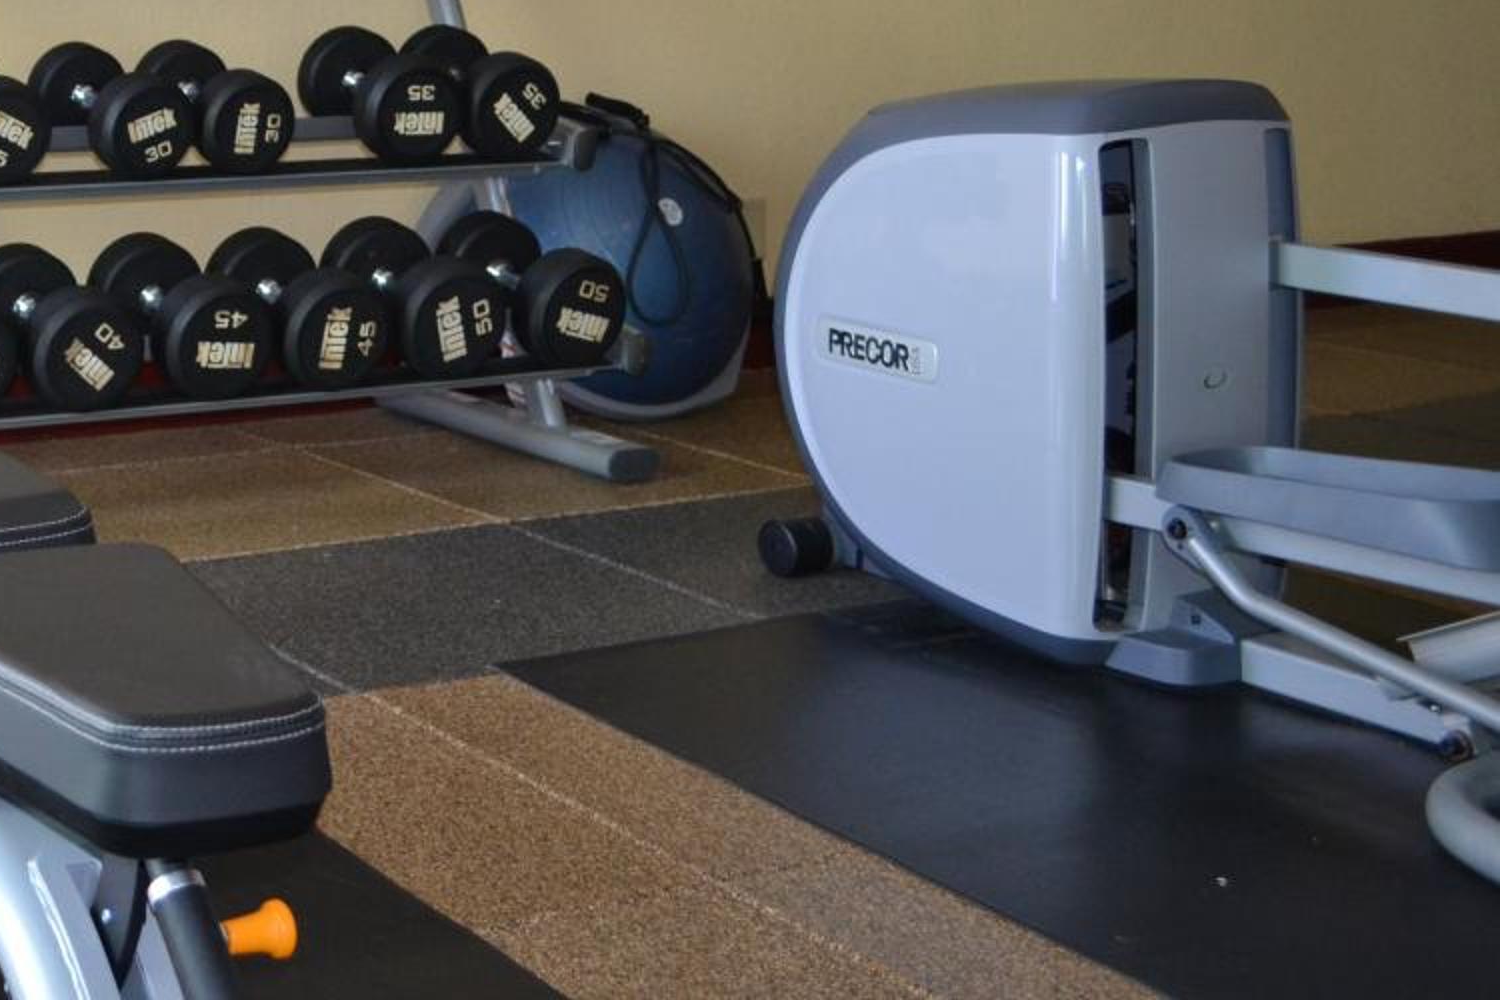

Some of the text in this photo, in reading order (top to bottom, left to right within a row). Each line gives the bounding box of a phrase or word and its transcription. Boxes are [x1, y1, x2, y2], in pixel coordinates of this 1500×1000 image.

[408, 85, 436, 101] 35
[522, 83, 547, 110] 35
[265, 114, 281, 143] 30
[144, 140, 173, 163] 30
[579, 280, 610, 303] 50
[214, 310, 248, 329] 45
[473, 299, 493, 336] 50
[94, 322, 125, 350] 40
[356, 321, 376, 357] 45
[828, 327, 909, 371] PRECOR
